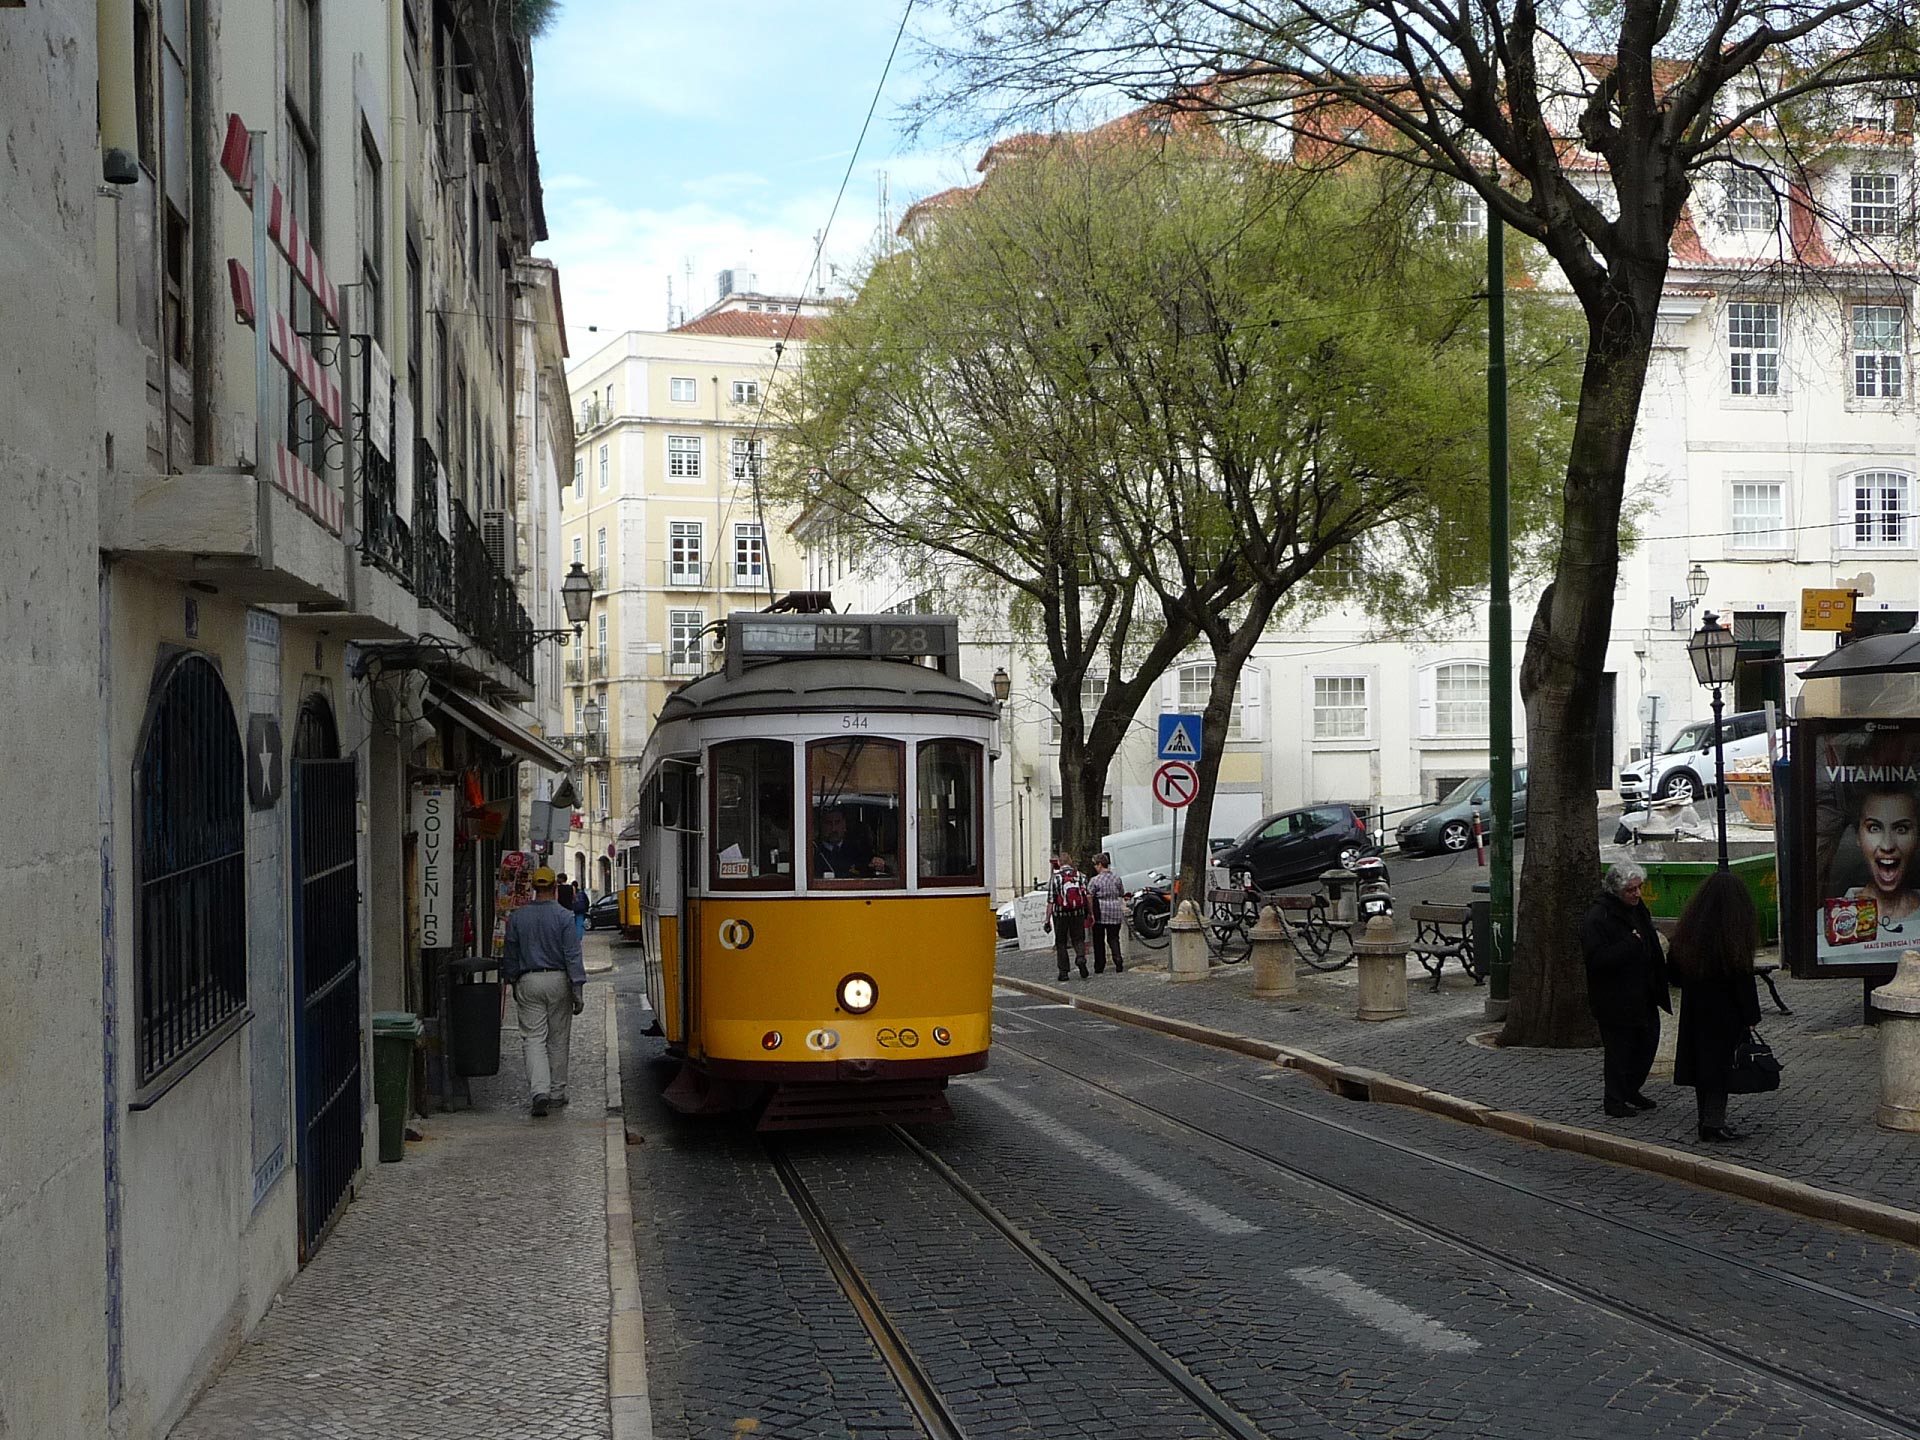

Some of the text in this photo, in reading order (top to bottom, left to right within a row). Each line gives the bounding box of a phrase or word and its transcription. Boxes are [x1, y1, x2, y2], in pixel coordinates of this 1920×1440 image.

[890, 628, 929, 651] 28
[842, 715, 868, 729] 544
[423, 798, 441, 947] SOUVENIRS
